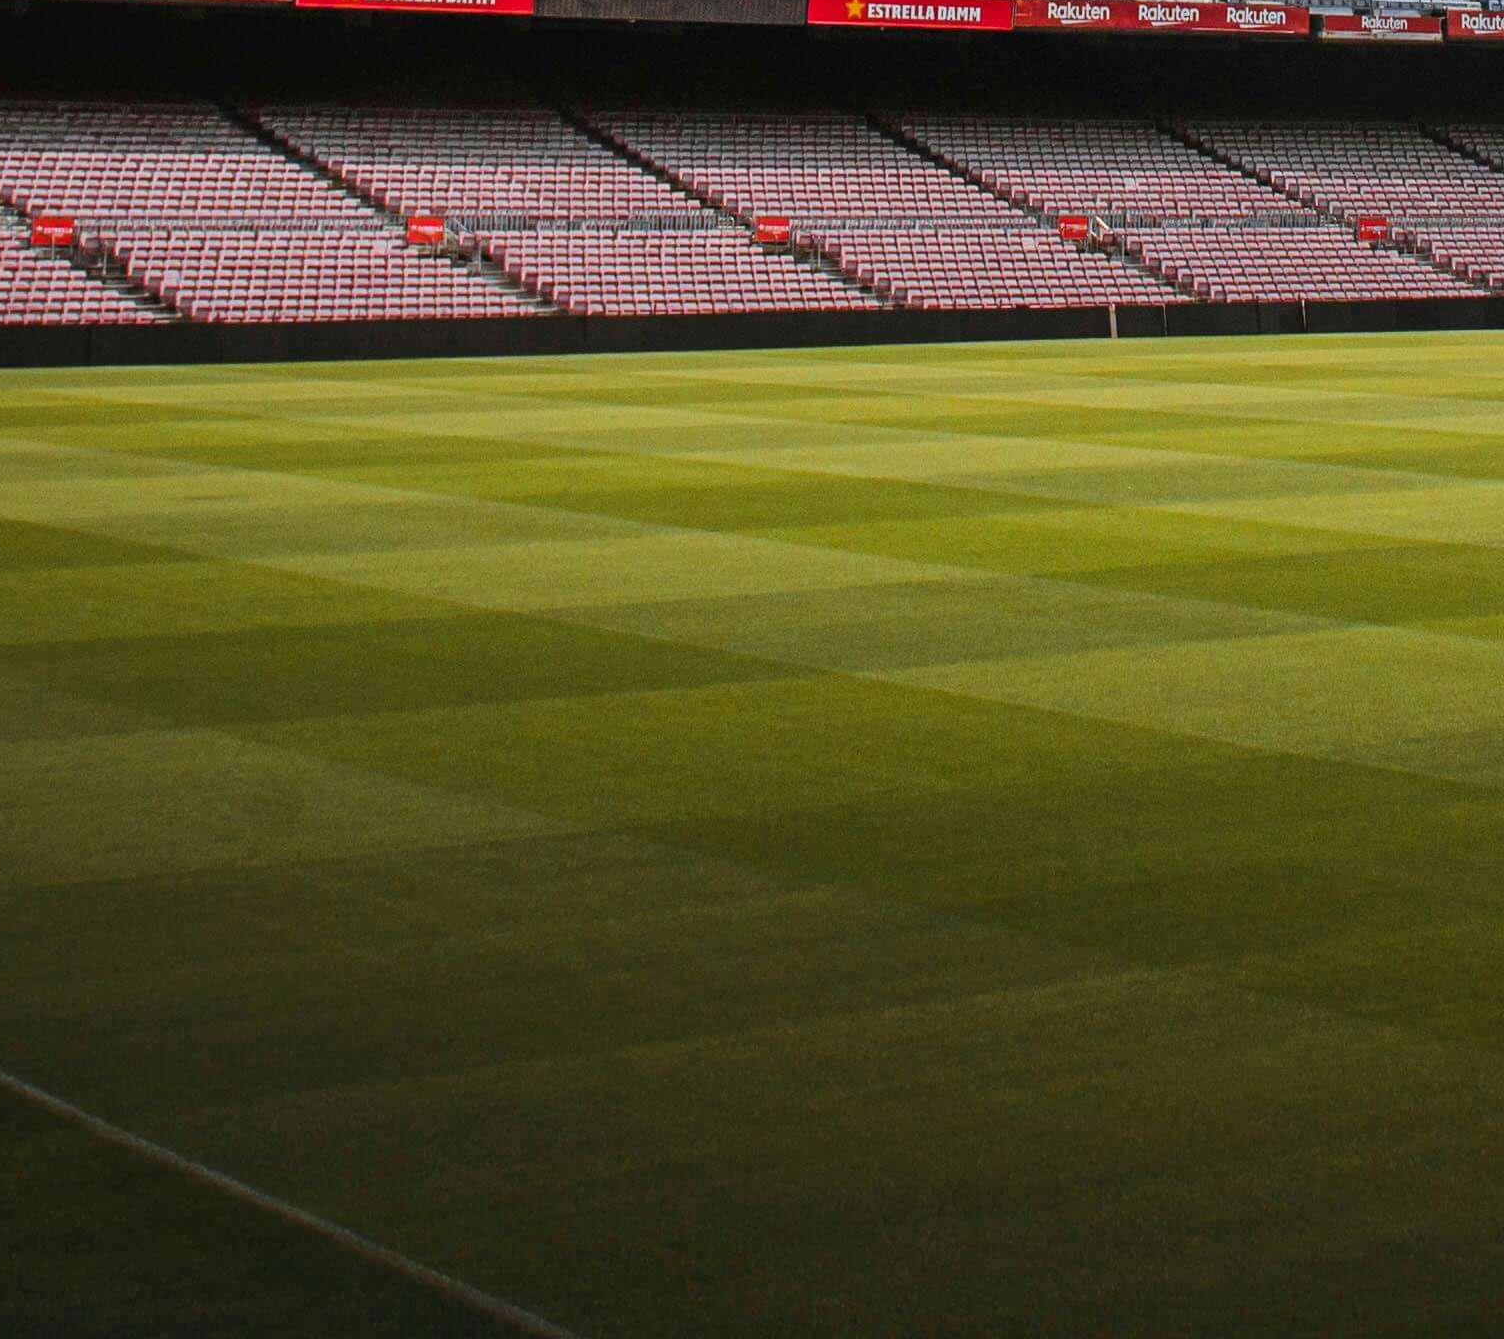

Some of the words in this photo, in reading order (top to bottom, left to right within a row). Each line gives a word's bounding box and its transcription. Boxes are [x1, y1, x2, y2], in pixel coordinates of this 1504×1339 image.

[867, 2, 934, 20] ESTRELLA
[937, 4, 981, 22] DAMM
[1048, 1, 1110, 22] Rakuten
[1138, 4, 1199, 23] Rakuten
[1226, 6, 1286, 26] Rakuten
[1361, 15, 1407, 31] Rakuten
